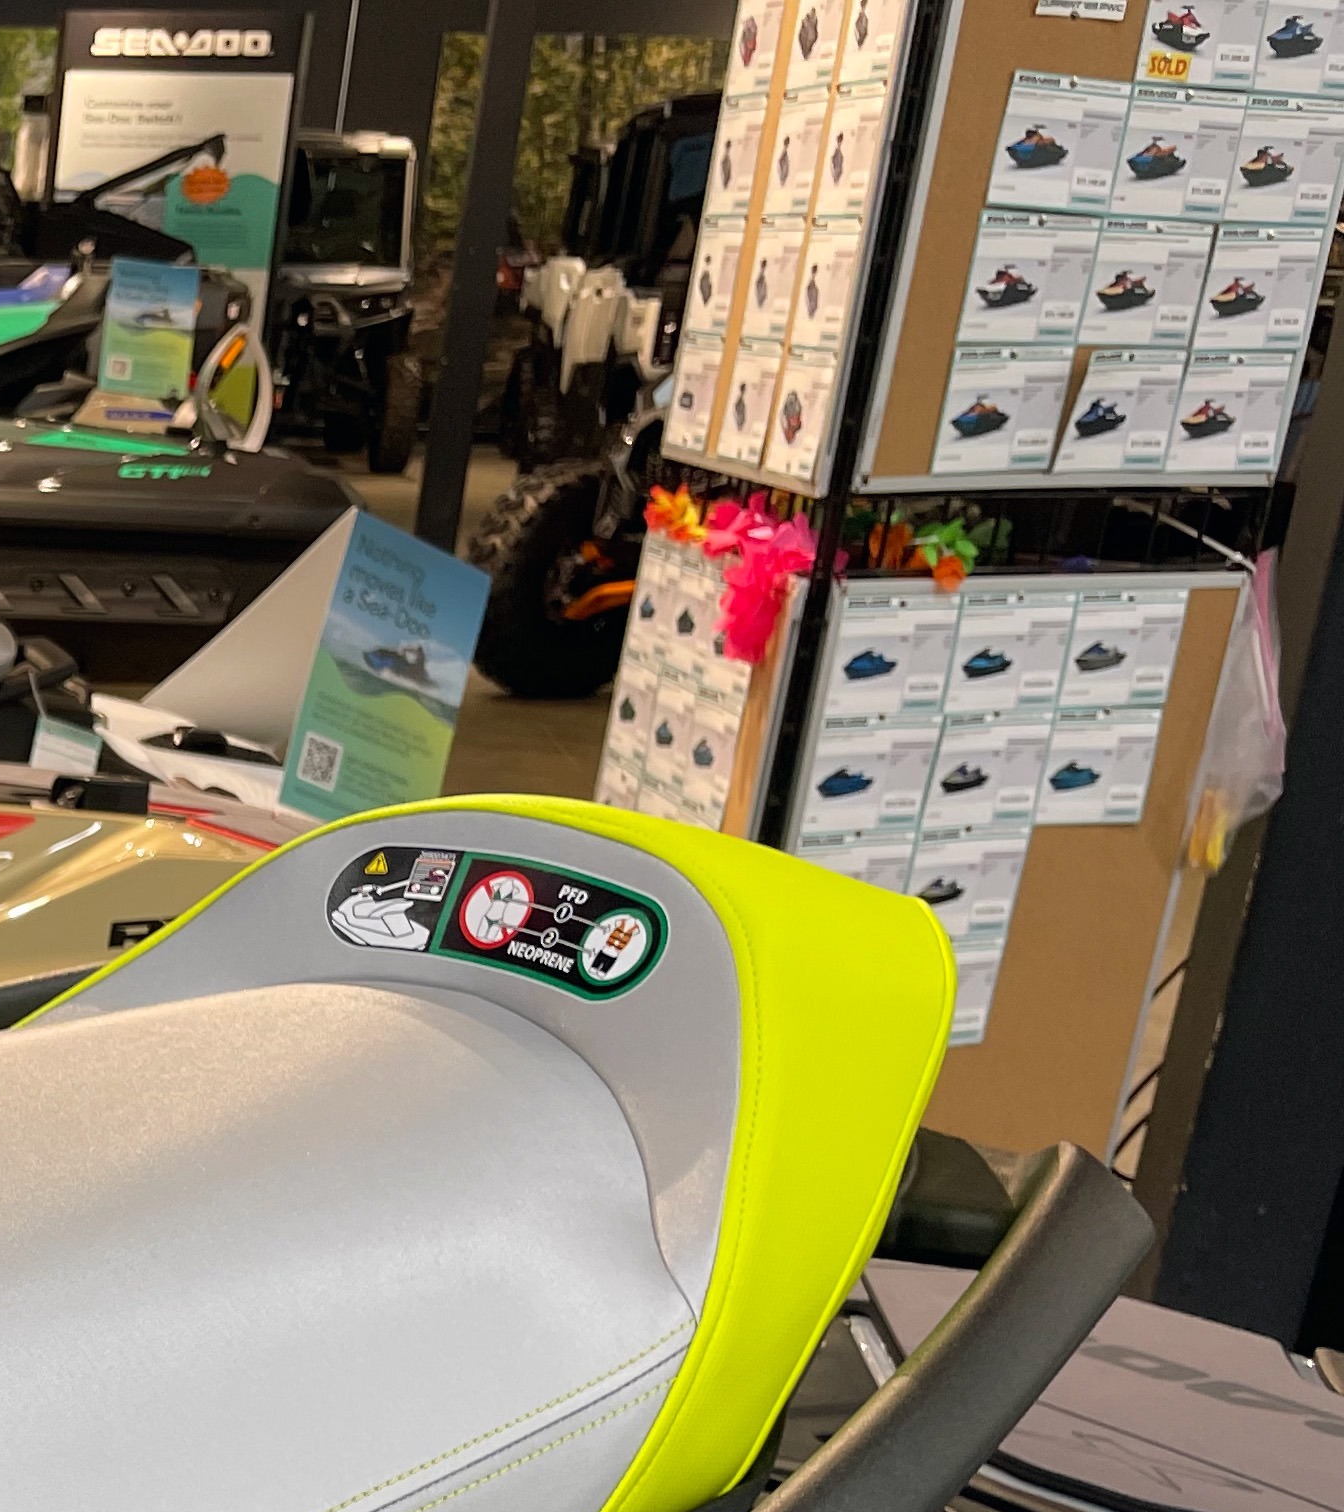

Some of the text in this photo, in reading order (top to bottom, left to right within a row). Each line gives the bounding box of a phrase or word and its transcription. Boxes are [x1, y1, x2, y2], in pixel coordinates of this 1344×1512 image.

[1149, 56, 1188, 76] SOLD
[558, 884, 589, 905] PFD
[507, 940, 575, 974] NEOPRENE
